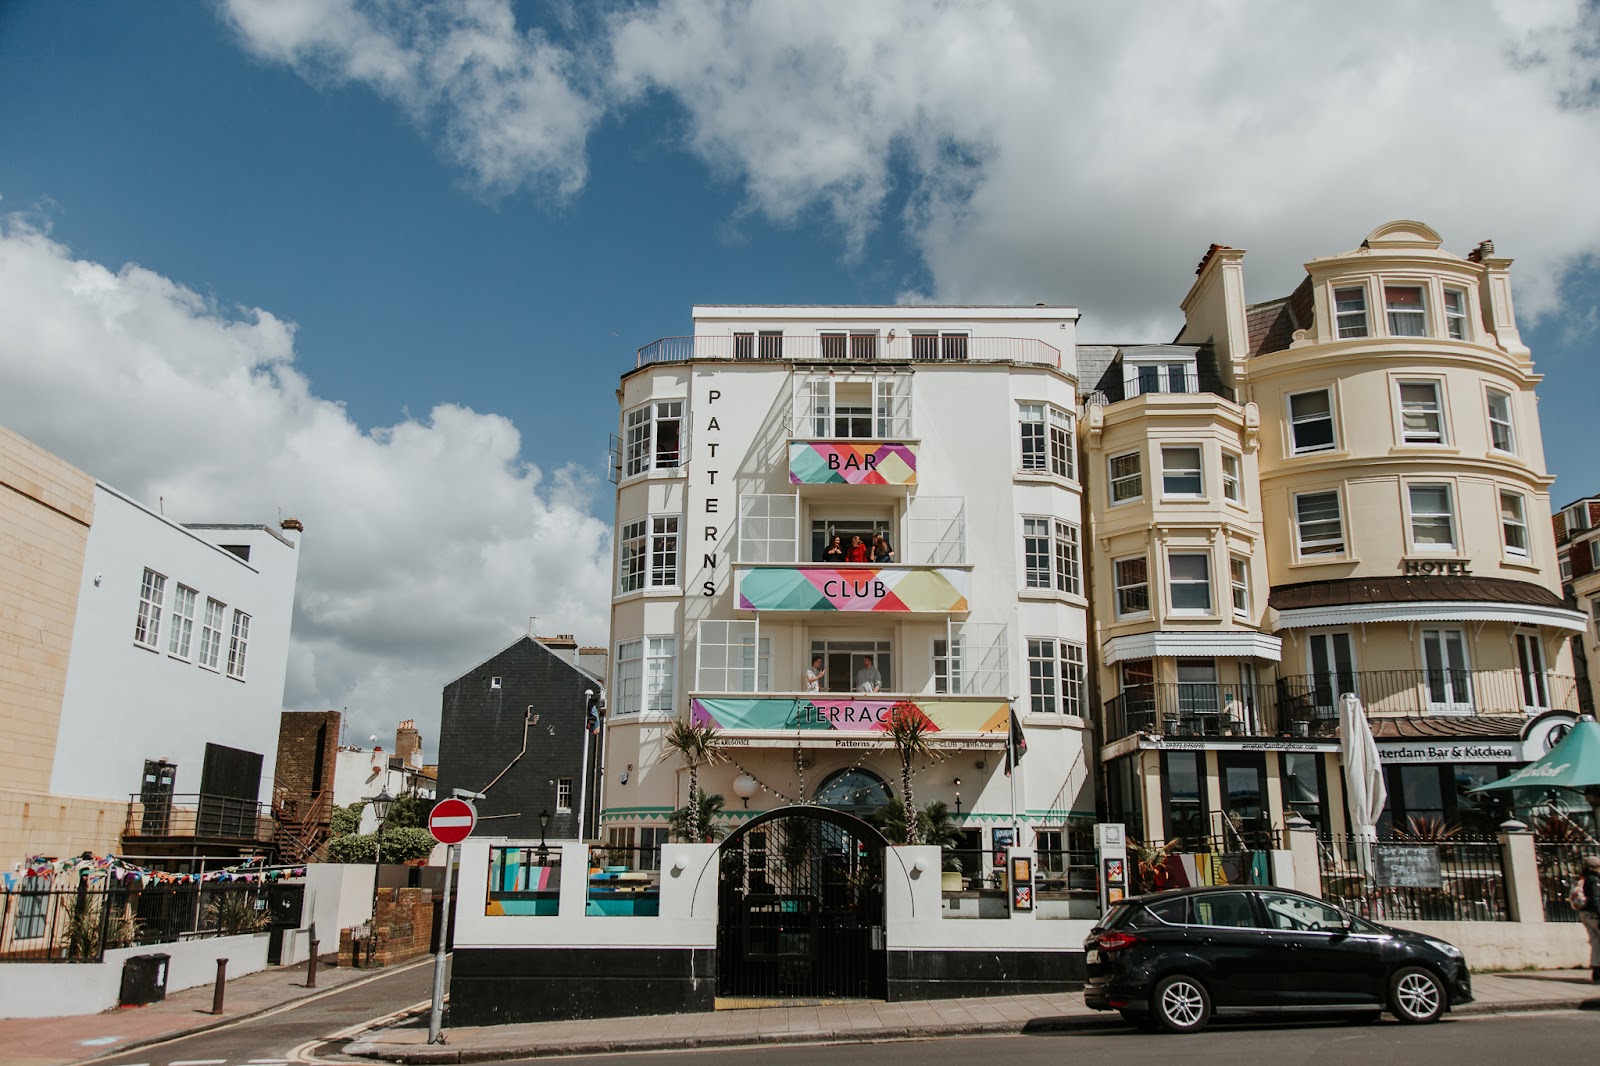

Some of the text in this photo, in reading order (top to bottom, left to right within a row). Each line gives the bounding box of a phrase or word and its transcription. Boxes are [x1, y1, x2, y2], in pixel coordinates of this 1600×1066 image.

[828, 453, 876, 471] BAR
[703, 390, 721, 597] PATTERNS
[1405, 561, 1473, 574] HOTEL
[824, 580, 886, 598] CLUB
[804, 706, 901, 723] TERRACE
[835, 740, 871, 748] Patterns
[1379, 745, 1512, 758] sterdam Bar & Kitchen
